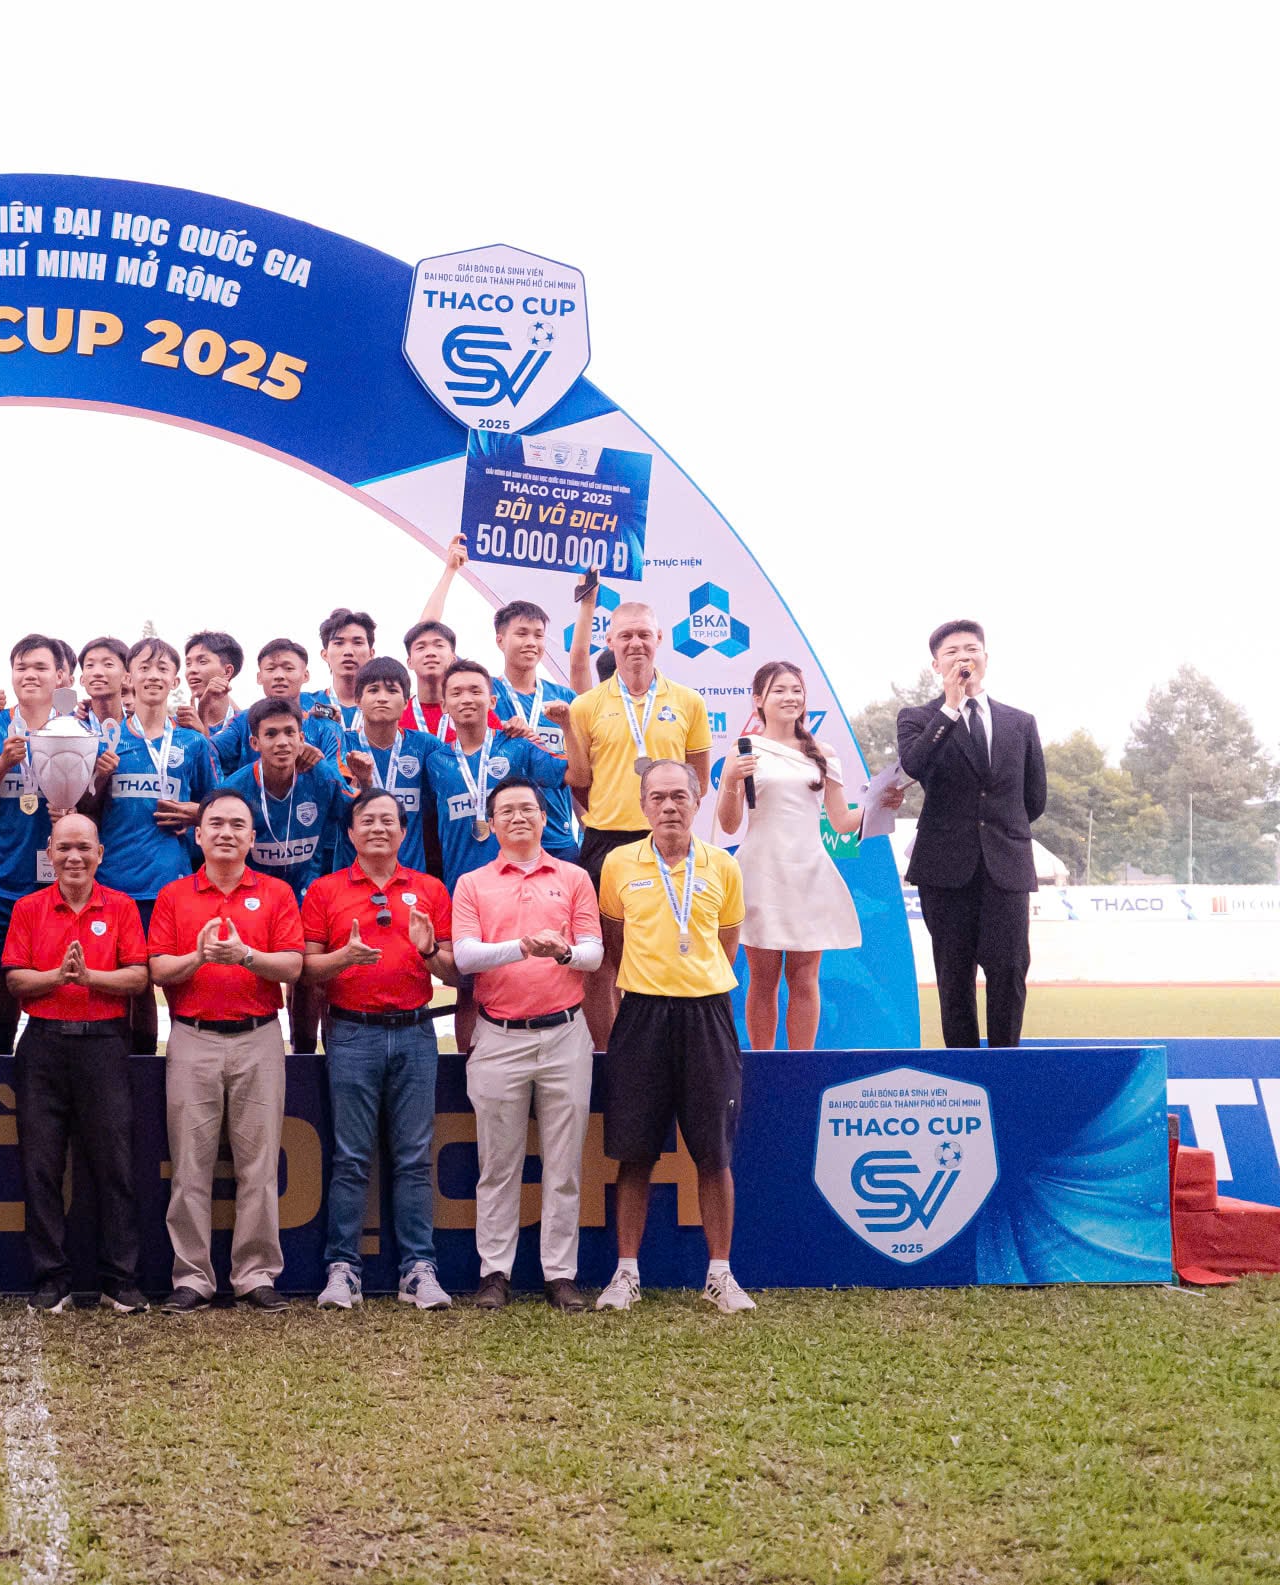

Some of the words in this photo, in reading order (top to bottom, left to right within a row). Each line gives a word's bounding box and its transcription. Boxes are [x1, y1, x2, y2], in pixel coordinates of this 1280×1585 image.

[54, 207, 101, 238] ĐẠI
[111, 212, 169, 248] HỌC
[178, 229, 257, 269] QUỐC
[263, 247, 313, 288] GIA
[37, 248, 106, 282] MINH
[115, 250, 160, 288] MỞ
[166, 266, 241, 307] RỘNG
[508, 266, 524, 276] SINH
[476, 276, 488, 284] GIA
[544, 280, 556, 288] CHÍ
[558, 282, 576, 290] MINH
[423, 290, 514, 312] THACO
[522, 297, 576, 316] CUP
[141, 318, 310, 401] 2025
[478, 418, 510, 430] 2025
[502, 480, 549, 498] THACO
[552, 487, 580, 500] CUP
[582, 491, 612, 506] 2025
[495, 497, 532, 524] ĐỘI
[538, 501, 566, 525] VÔ
[570, 509, 618, 534] ĐỊCH
[476, 523, 608, 570] 50.000.000
[613, 541, 628, 572] Đ
[652, 558, 679, 568] THỰC
[680, 556, 702, 567] HIỆN
[692, 614, 728, 628] BKA
[694, 630, 728, 638] TP.HCM
[258, 843, 314, 860] THACO
[1090, 898, 1164, 912] THACO
[911, 1088, 928, 1096] SINH
[880, 1100, 892, 1108] GIA
[948, 1098, 960, 1107] CHÍ
[828, 1118, 920, 1136] THACO
[928, 1116, 982, 1136] CUP
[891, 1244, 924, 1254] 2025
